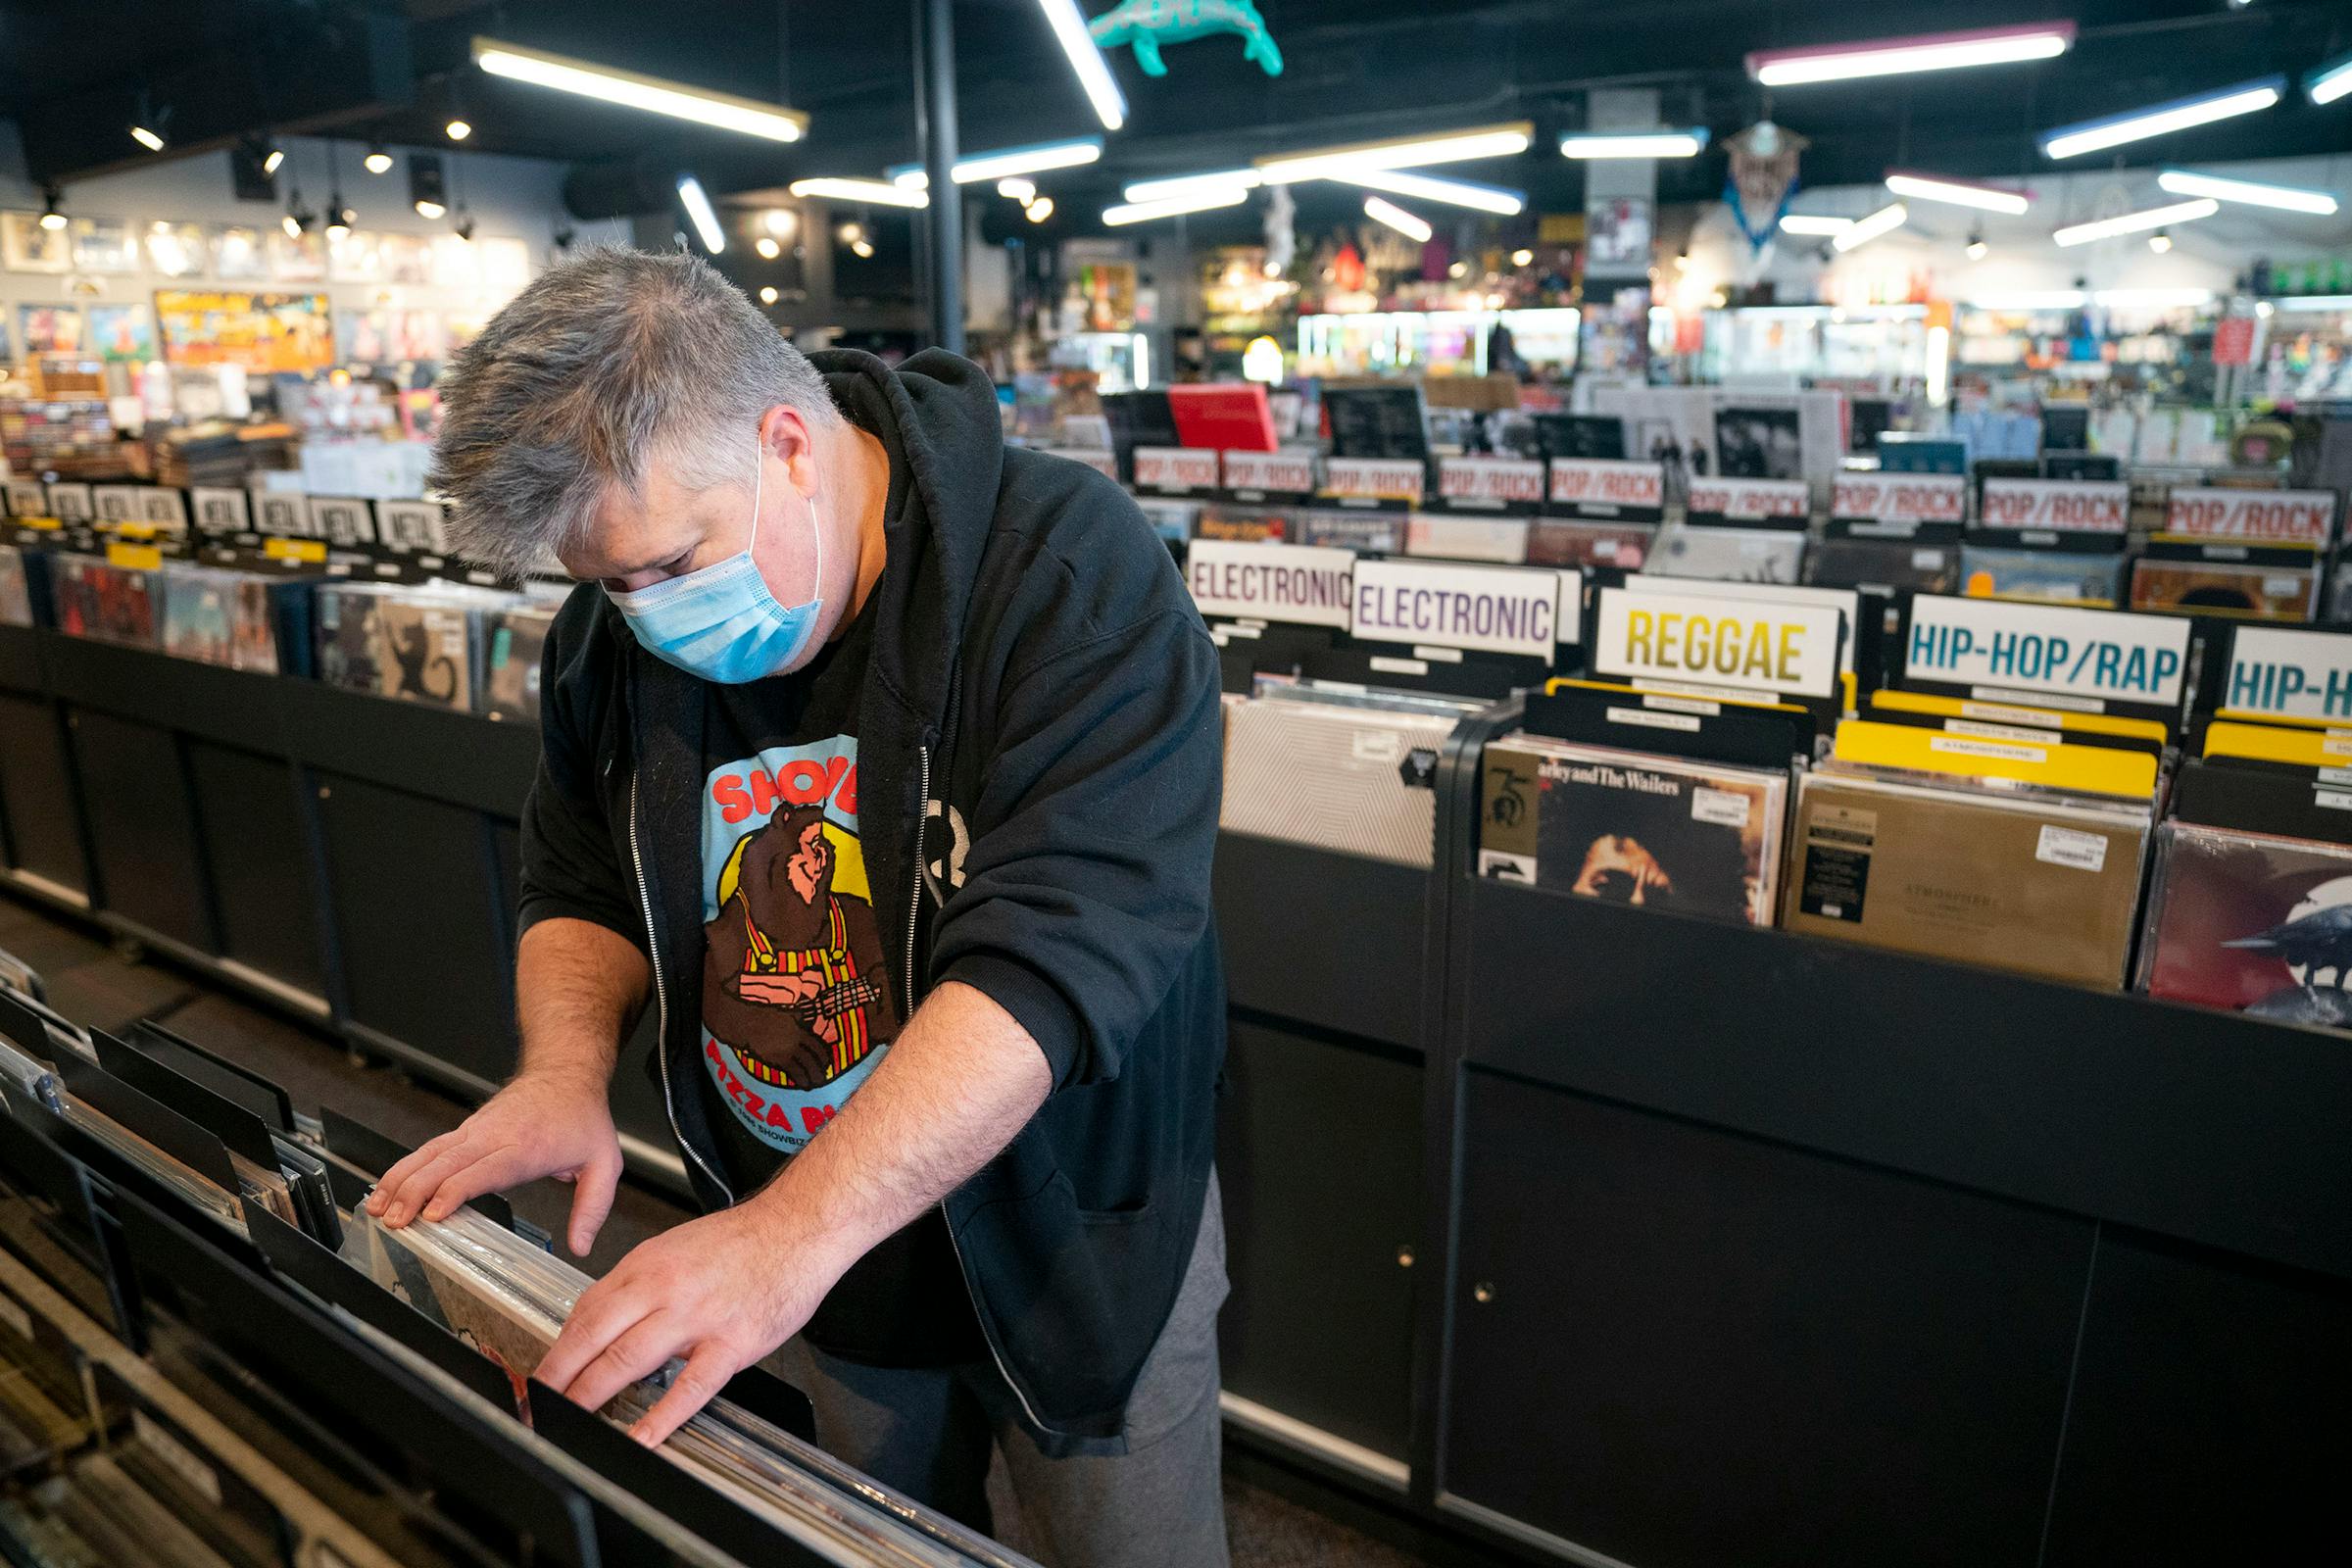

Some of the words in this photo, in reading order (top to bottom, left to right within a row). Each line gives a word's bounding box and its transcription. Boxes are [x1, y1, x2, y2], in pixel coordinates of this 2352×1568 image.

[1550, 469, 1661, 506] POP/ROCK
[1831, 483, 1963, 520] POP/ROCK
[1982, 491, 2127, 530] POP/ROCK
[2165, 498, 2328, 540] POP/ROCK
[1194, 561, 1352, 612] ELECTRONIC
[1358, 584, 1550, 644] ELECTRONIC
[1626, 609, 1807, 684] REGGAE
[1912, 621, 2180, 695] HIP-HOP/RAP
[1572, 765, 1598, 785] and
[1598, 767, 1626, 789] The
[1626, 770, 1680, 796] Wailers
[706, 1038, 793, 1132] PIZZA
[758, 1123, 806, 1147] SHOWBIZ
